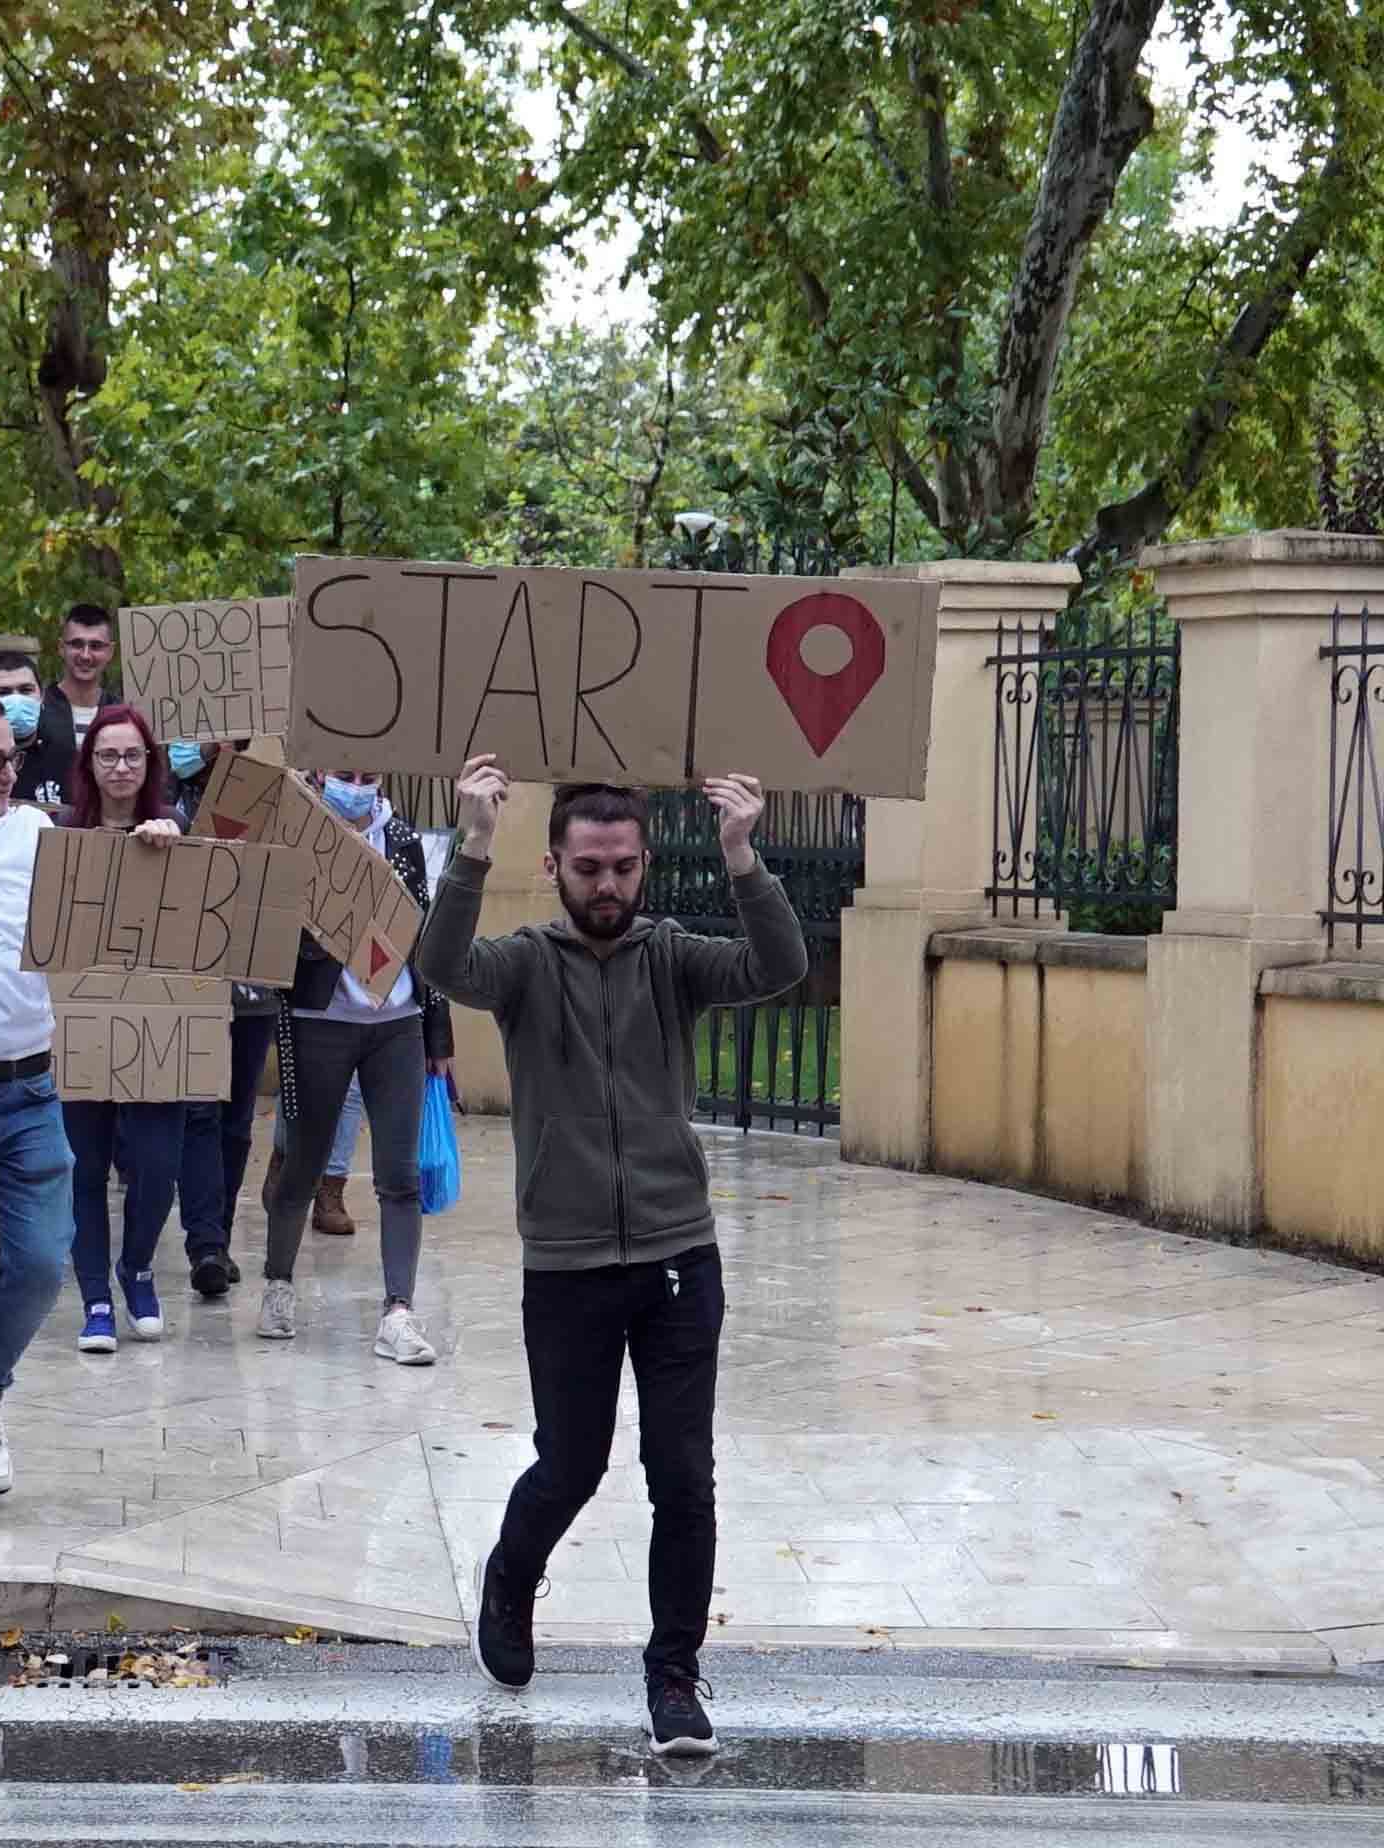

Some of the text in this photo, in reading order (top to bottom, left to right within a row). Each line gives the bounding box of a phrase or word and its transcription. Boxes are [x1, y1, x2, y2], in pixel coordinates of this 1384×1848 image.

[306, 570, 749, 778] START
[28, 829, 271, 978] UHLJEBI
[216, 755, 418, 935] FAJRUNT
